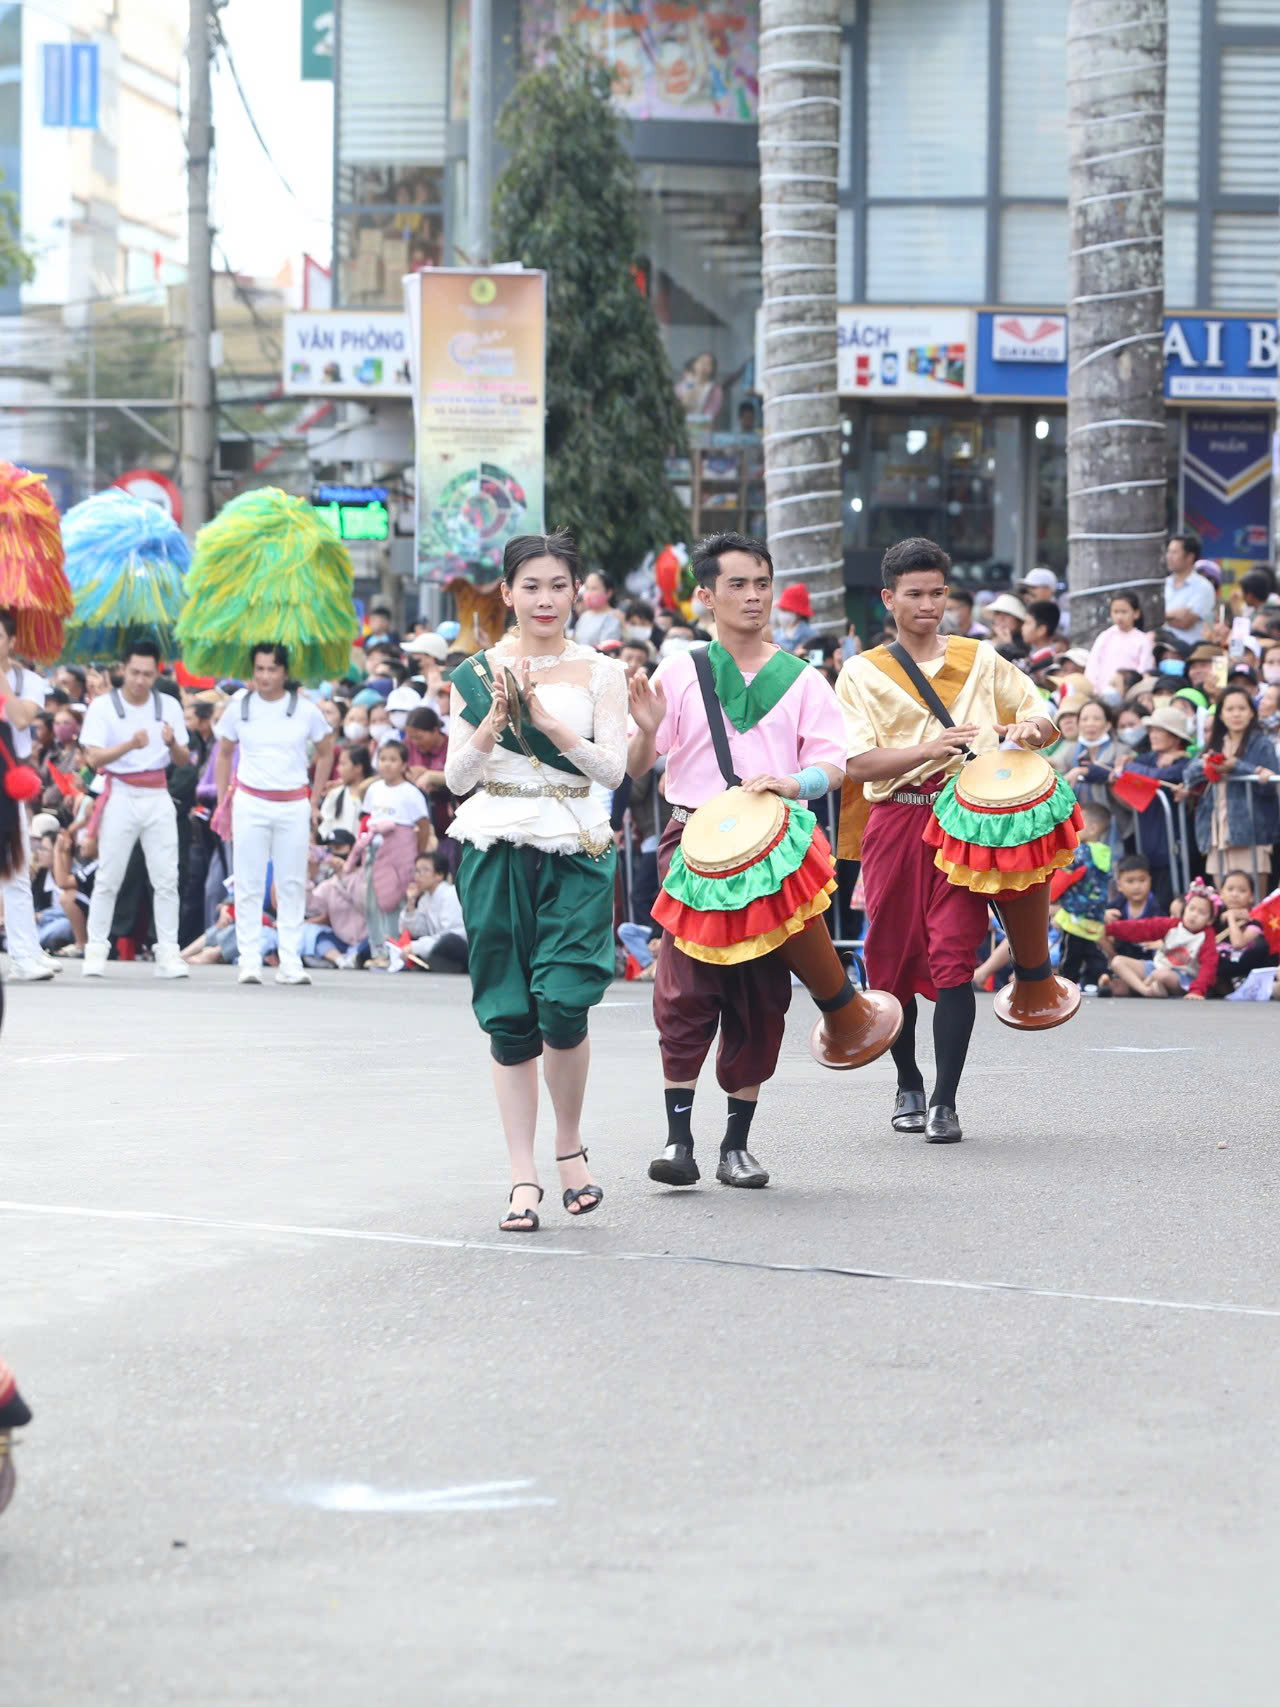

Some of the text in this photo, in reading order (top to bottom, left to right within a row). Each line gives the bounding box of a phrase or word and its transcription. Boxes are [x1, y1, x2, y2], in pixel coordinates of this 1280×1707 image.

[837, 321, 890, 347] SÁCH
[1163, 321, 1224, 369] AI
[1247, 321, 1279, 369] B
